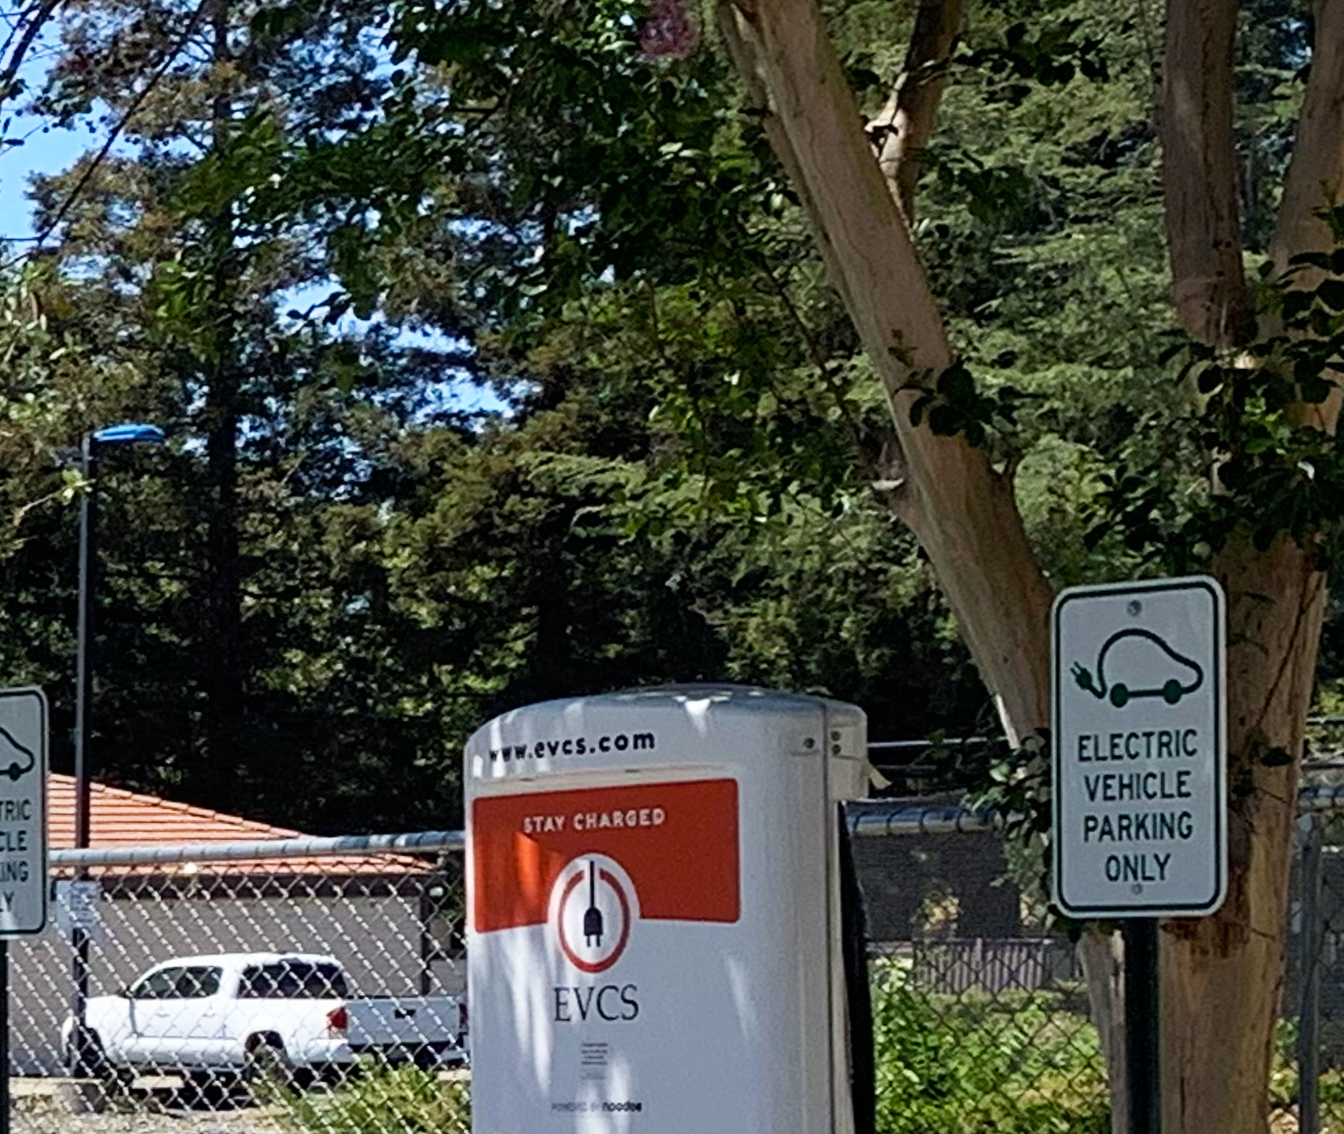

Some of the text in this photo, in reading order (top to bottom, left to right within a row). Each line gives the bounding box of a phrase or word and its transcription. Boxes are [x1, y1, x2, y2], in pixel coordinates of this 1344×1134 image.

[489, 732, 656, 761] www.evcs.com
[1077, 728, 1198, 762] ELECTRIC
[1083, 770, 1192, 802] VEHICLE
[523, 808, 666, 833] STAY CHARGED
[1083, 811, 1193, 843] PARKING
[1105, 853, 1172, 882] ONLY
[553, 984, 640, 1022] EVCS
